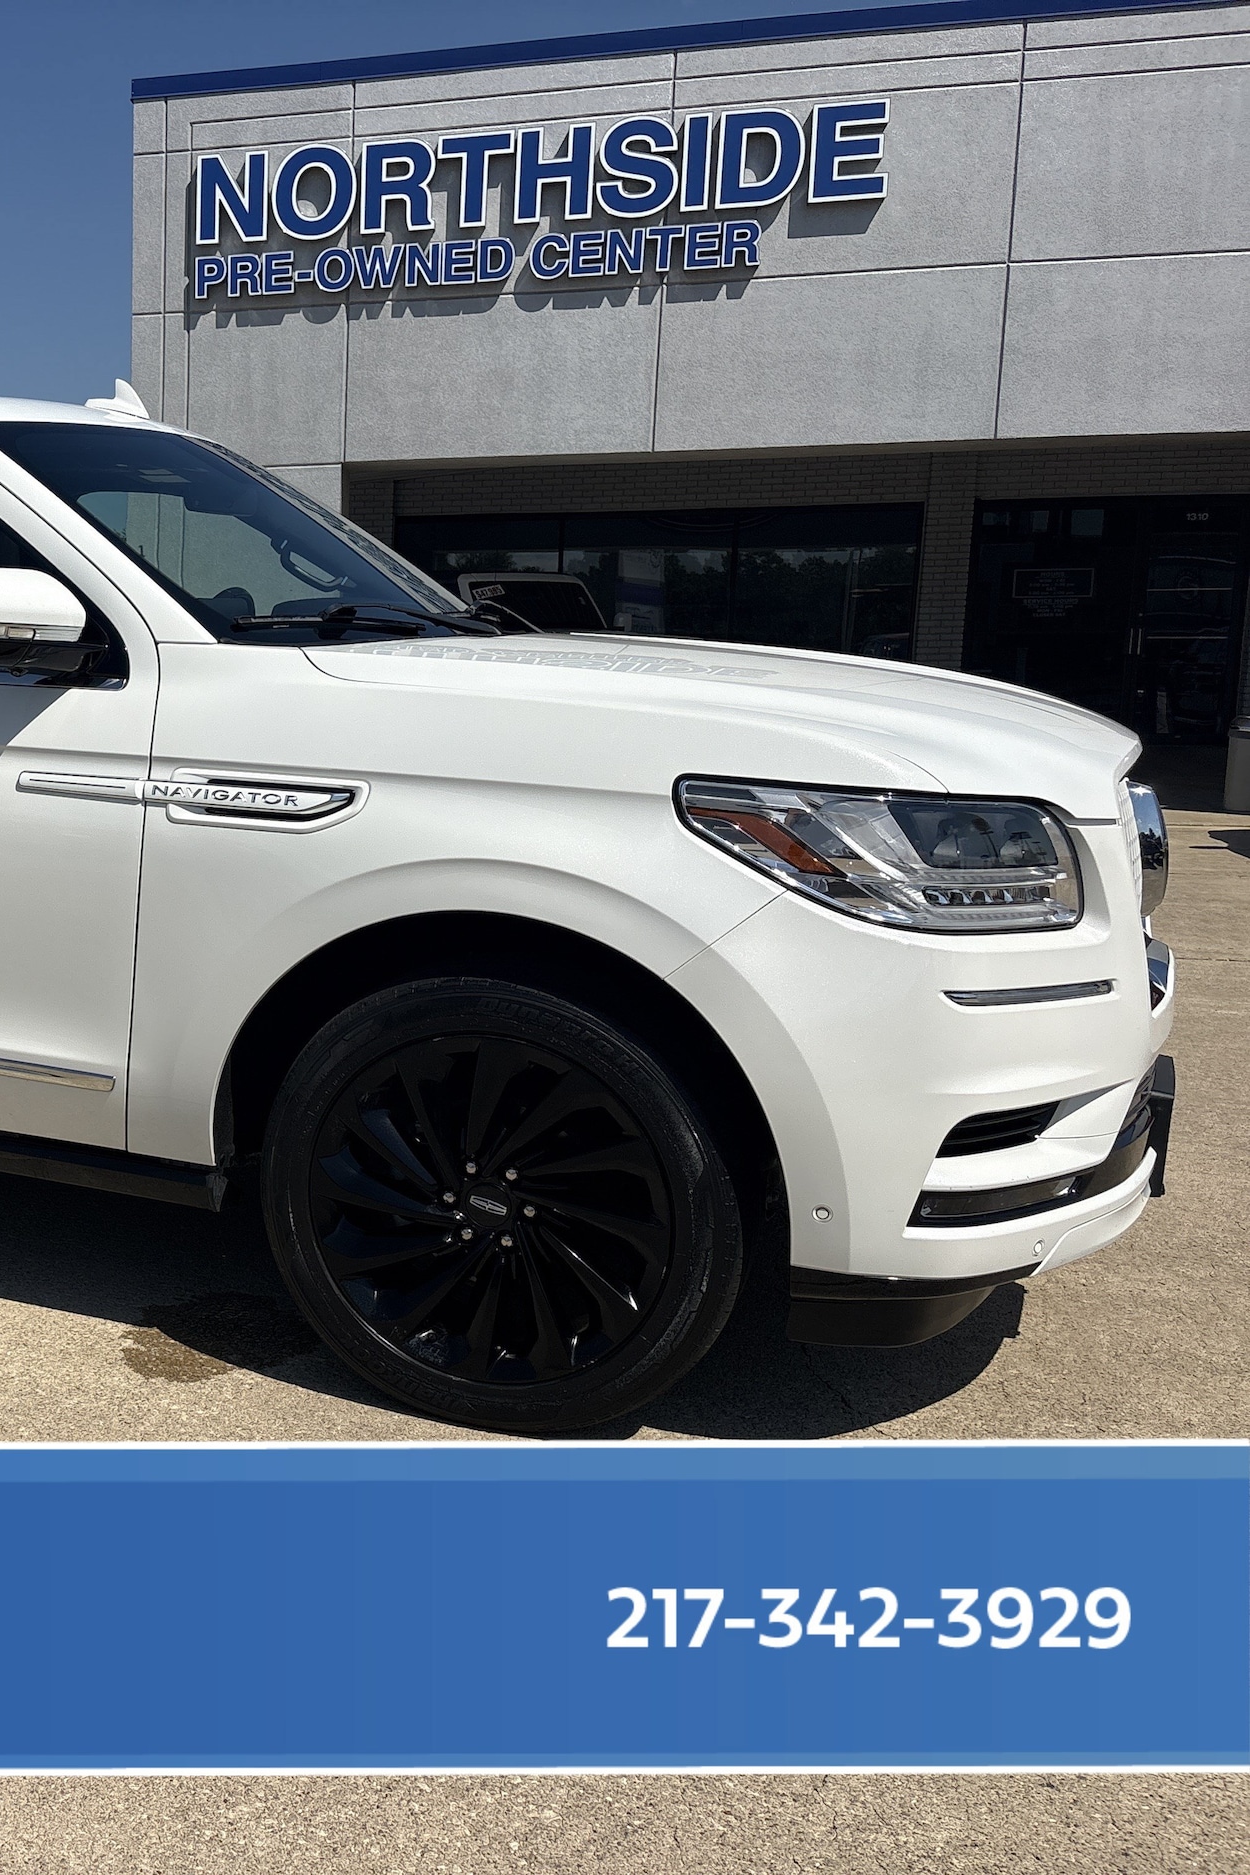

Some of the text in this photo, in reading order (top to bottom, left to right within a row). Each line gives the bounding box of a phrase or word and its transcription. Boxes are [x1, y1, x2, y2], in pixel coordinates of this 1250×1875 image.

[195, 97, 891, 246] NORTHSIDE
[194, 219, 763, 299] PRE-OWNED CENTER
[1186, 512, 1209, 521] 1310
[152, 784, 299, 806] NAVIGATOR
